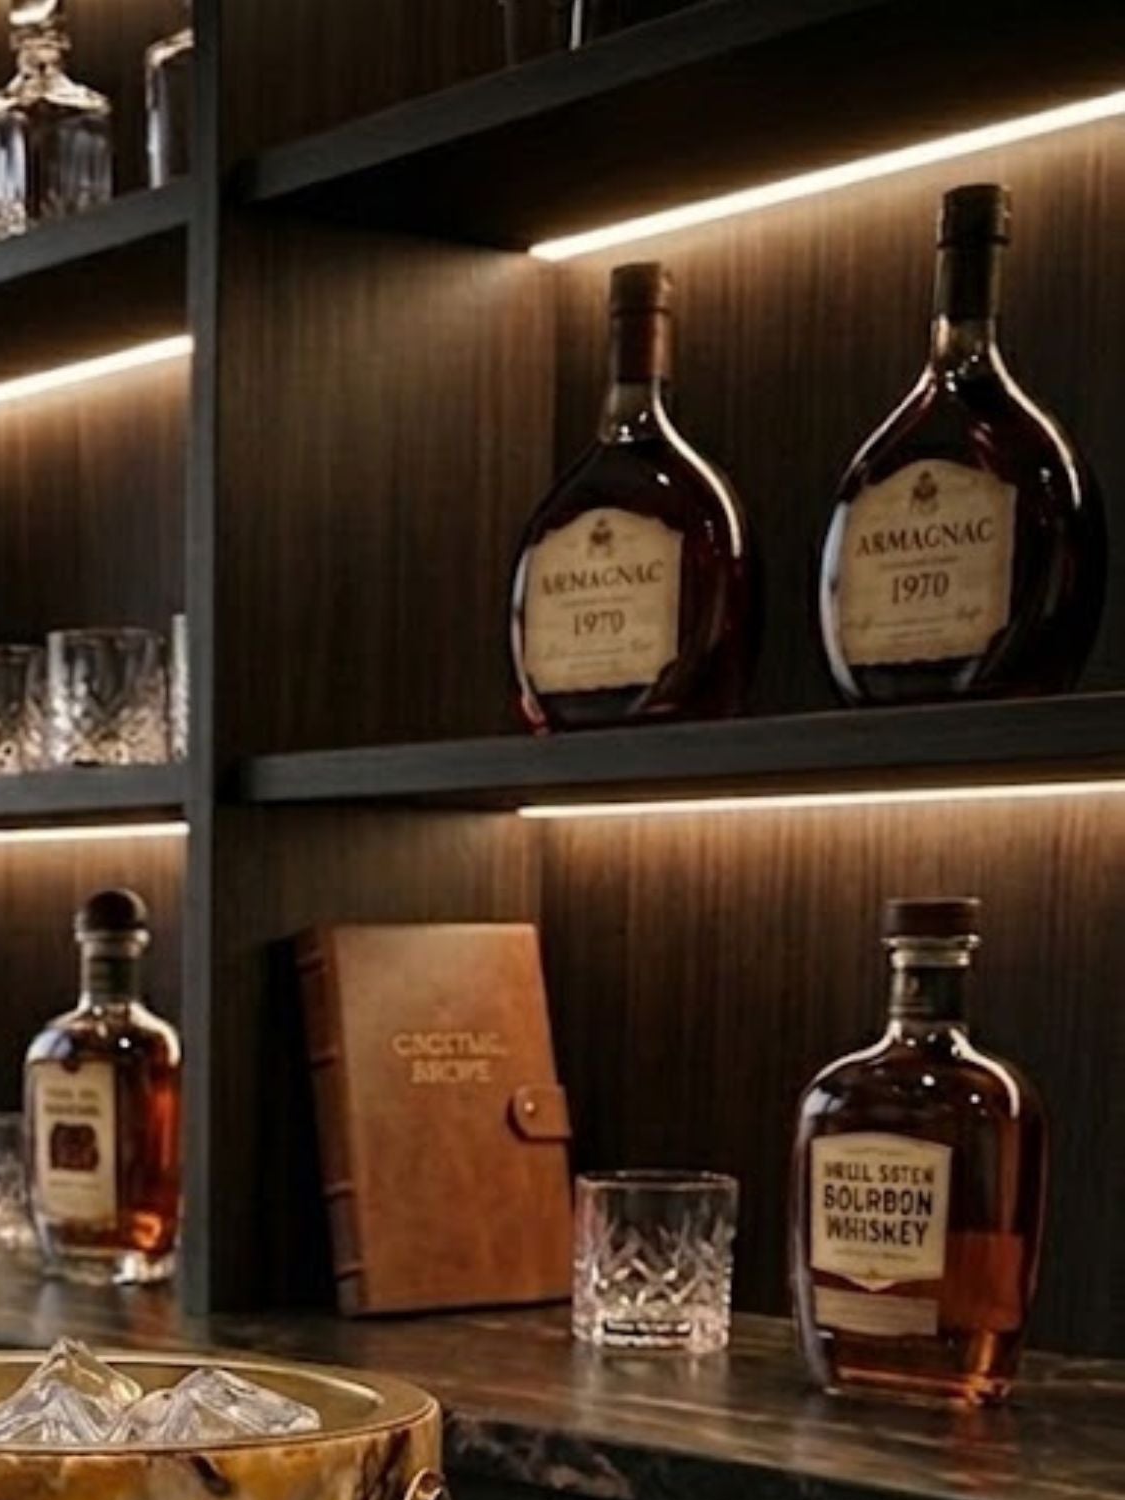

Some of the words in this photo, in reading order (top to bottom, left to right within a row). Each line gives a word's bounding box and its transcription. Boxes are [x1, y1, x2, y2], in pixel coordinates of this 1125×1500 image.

[854, 516, 993, 557] ARMAGNAC
[891, 571, 950, 605] 1970
[574, 608, 625, 636] 1970
[826, 1216, 929, 1247] WHISKEY
